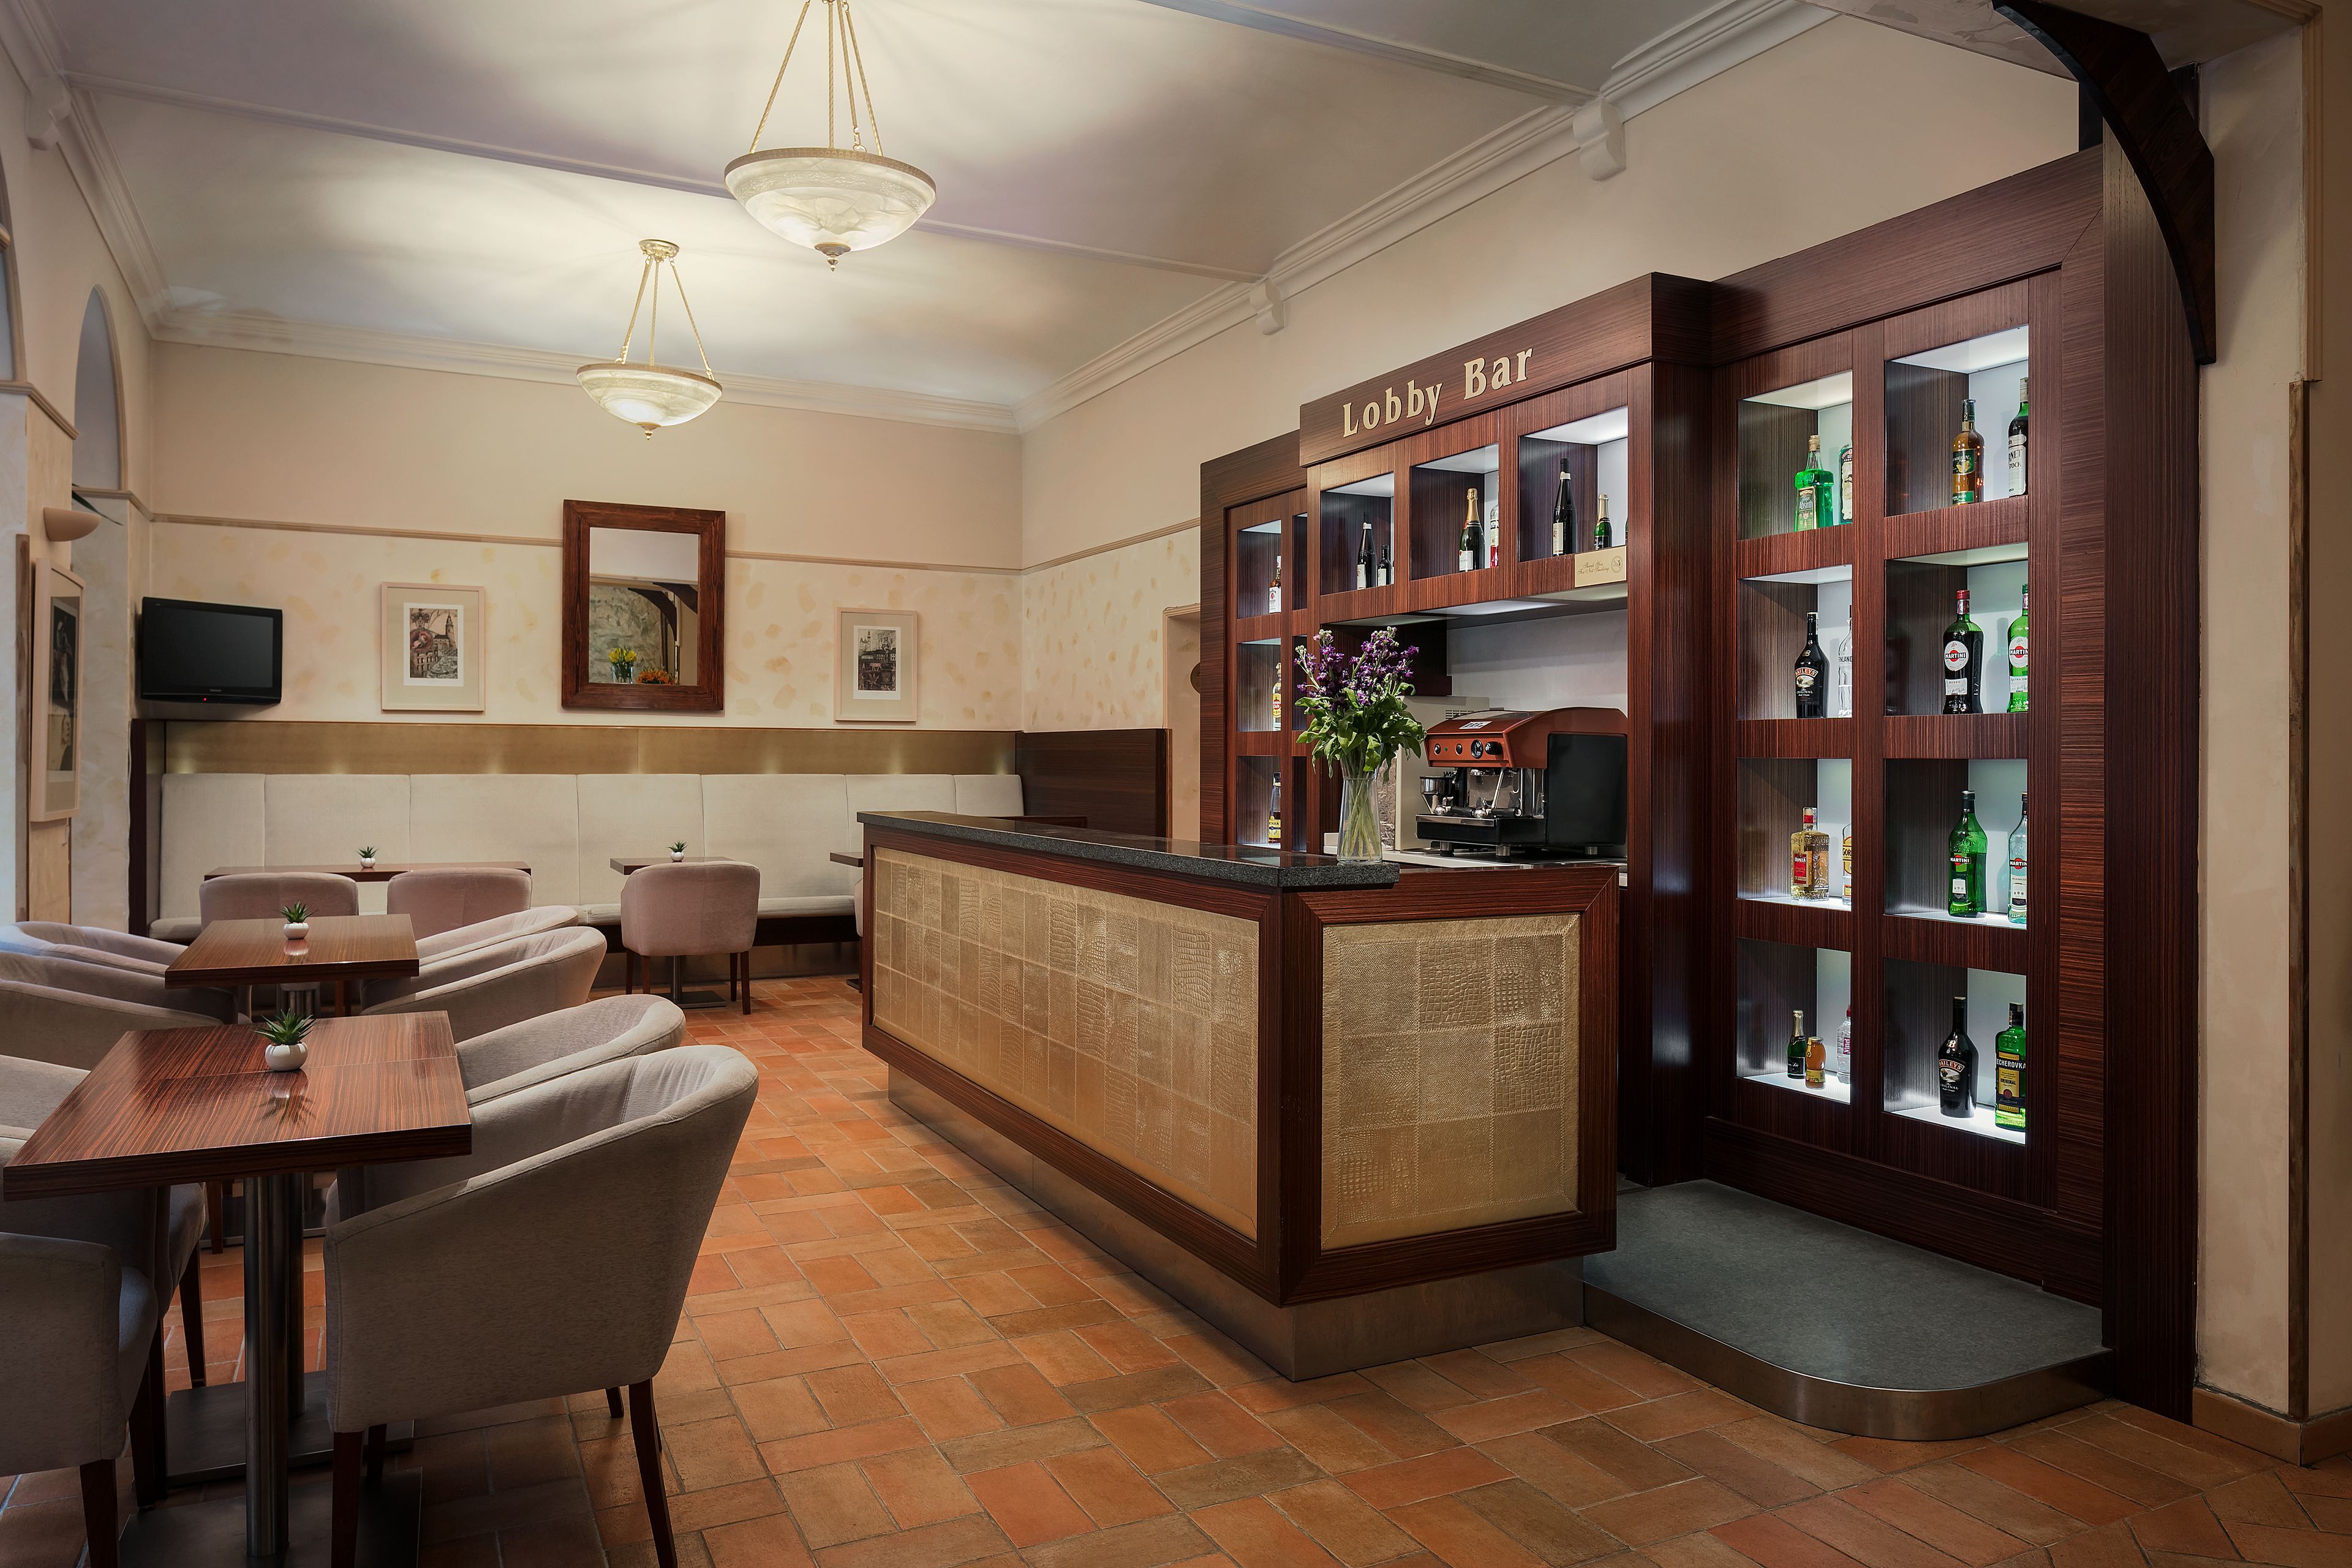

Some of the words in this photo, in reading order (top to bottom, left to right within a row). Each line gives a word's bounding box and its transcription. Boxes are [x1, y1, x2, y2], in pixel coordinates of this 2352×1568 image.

[1343, 379, 1442, 438] Lobby
[1464, 347, 1533, 401] Bar
[1997, 1059, 2026, 1069] ECHEROVKA
